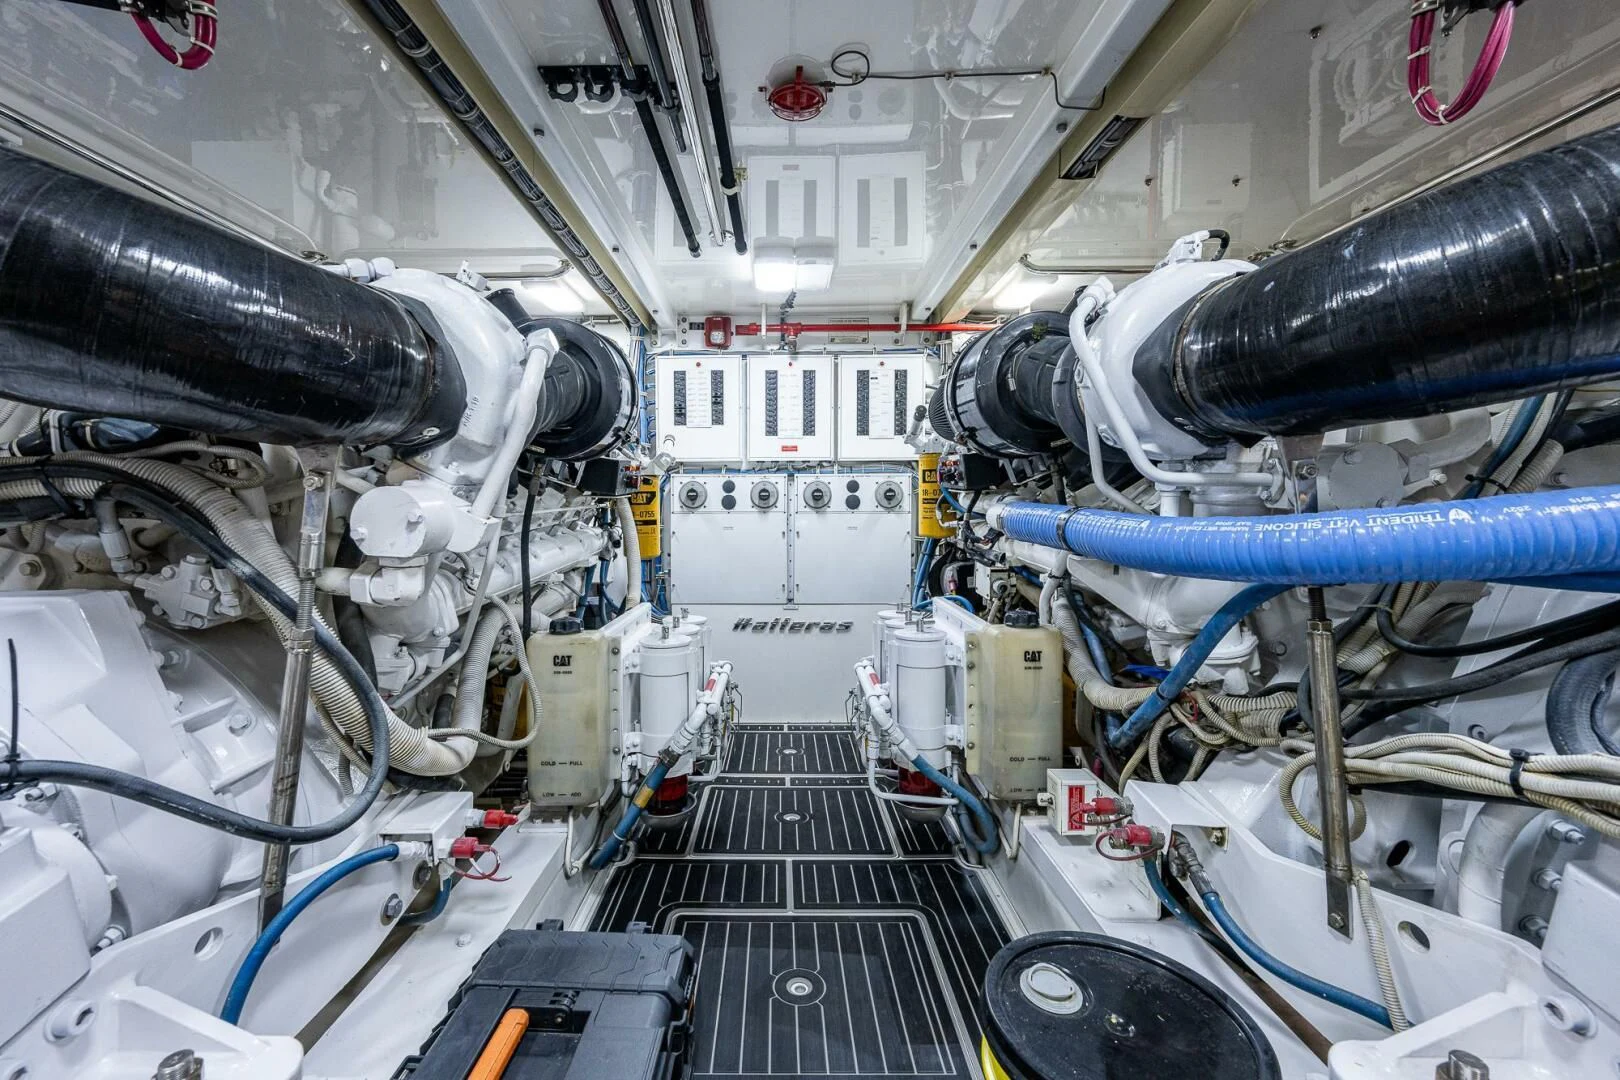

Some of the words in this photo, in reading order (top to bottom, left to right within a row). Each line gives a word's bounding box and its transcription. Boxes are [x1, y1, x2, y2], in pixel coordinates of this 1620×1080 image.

[925, 470, 937, 481] CA
[631, 492, 648, 504] CAT
[633, 510, 655, 518] -0755
[1365, 512, 1446, 527] TRIDENT
[1254, 521, 1322, 532] SILICONE
[1327, 518, 1360, 529] VHT
[553, 655, 572, 667] CAT
[1024, 650, 1042, 663] CAT
